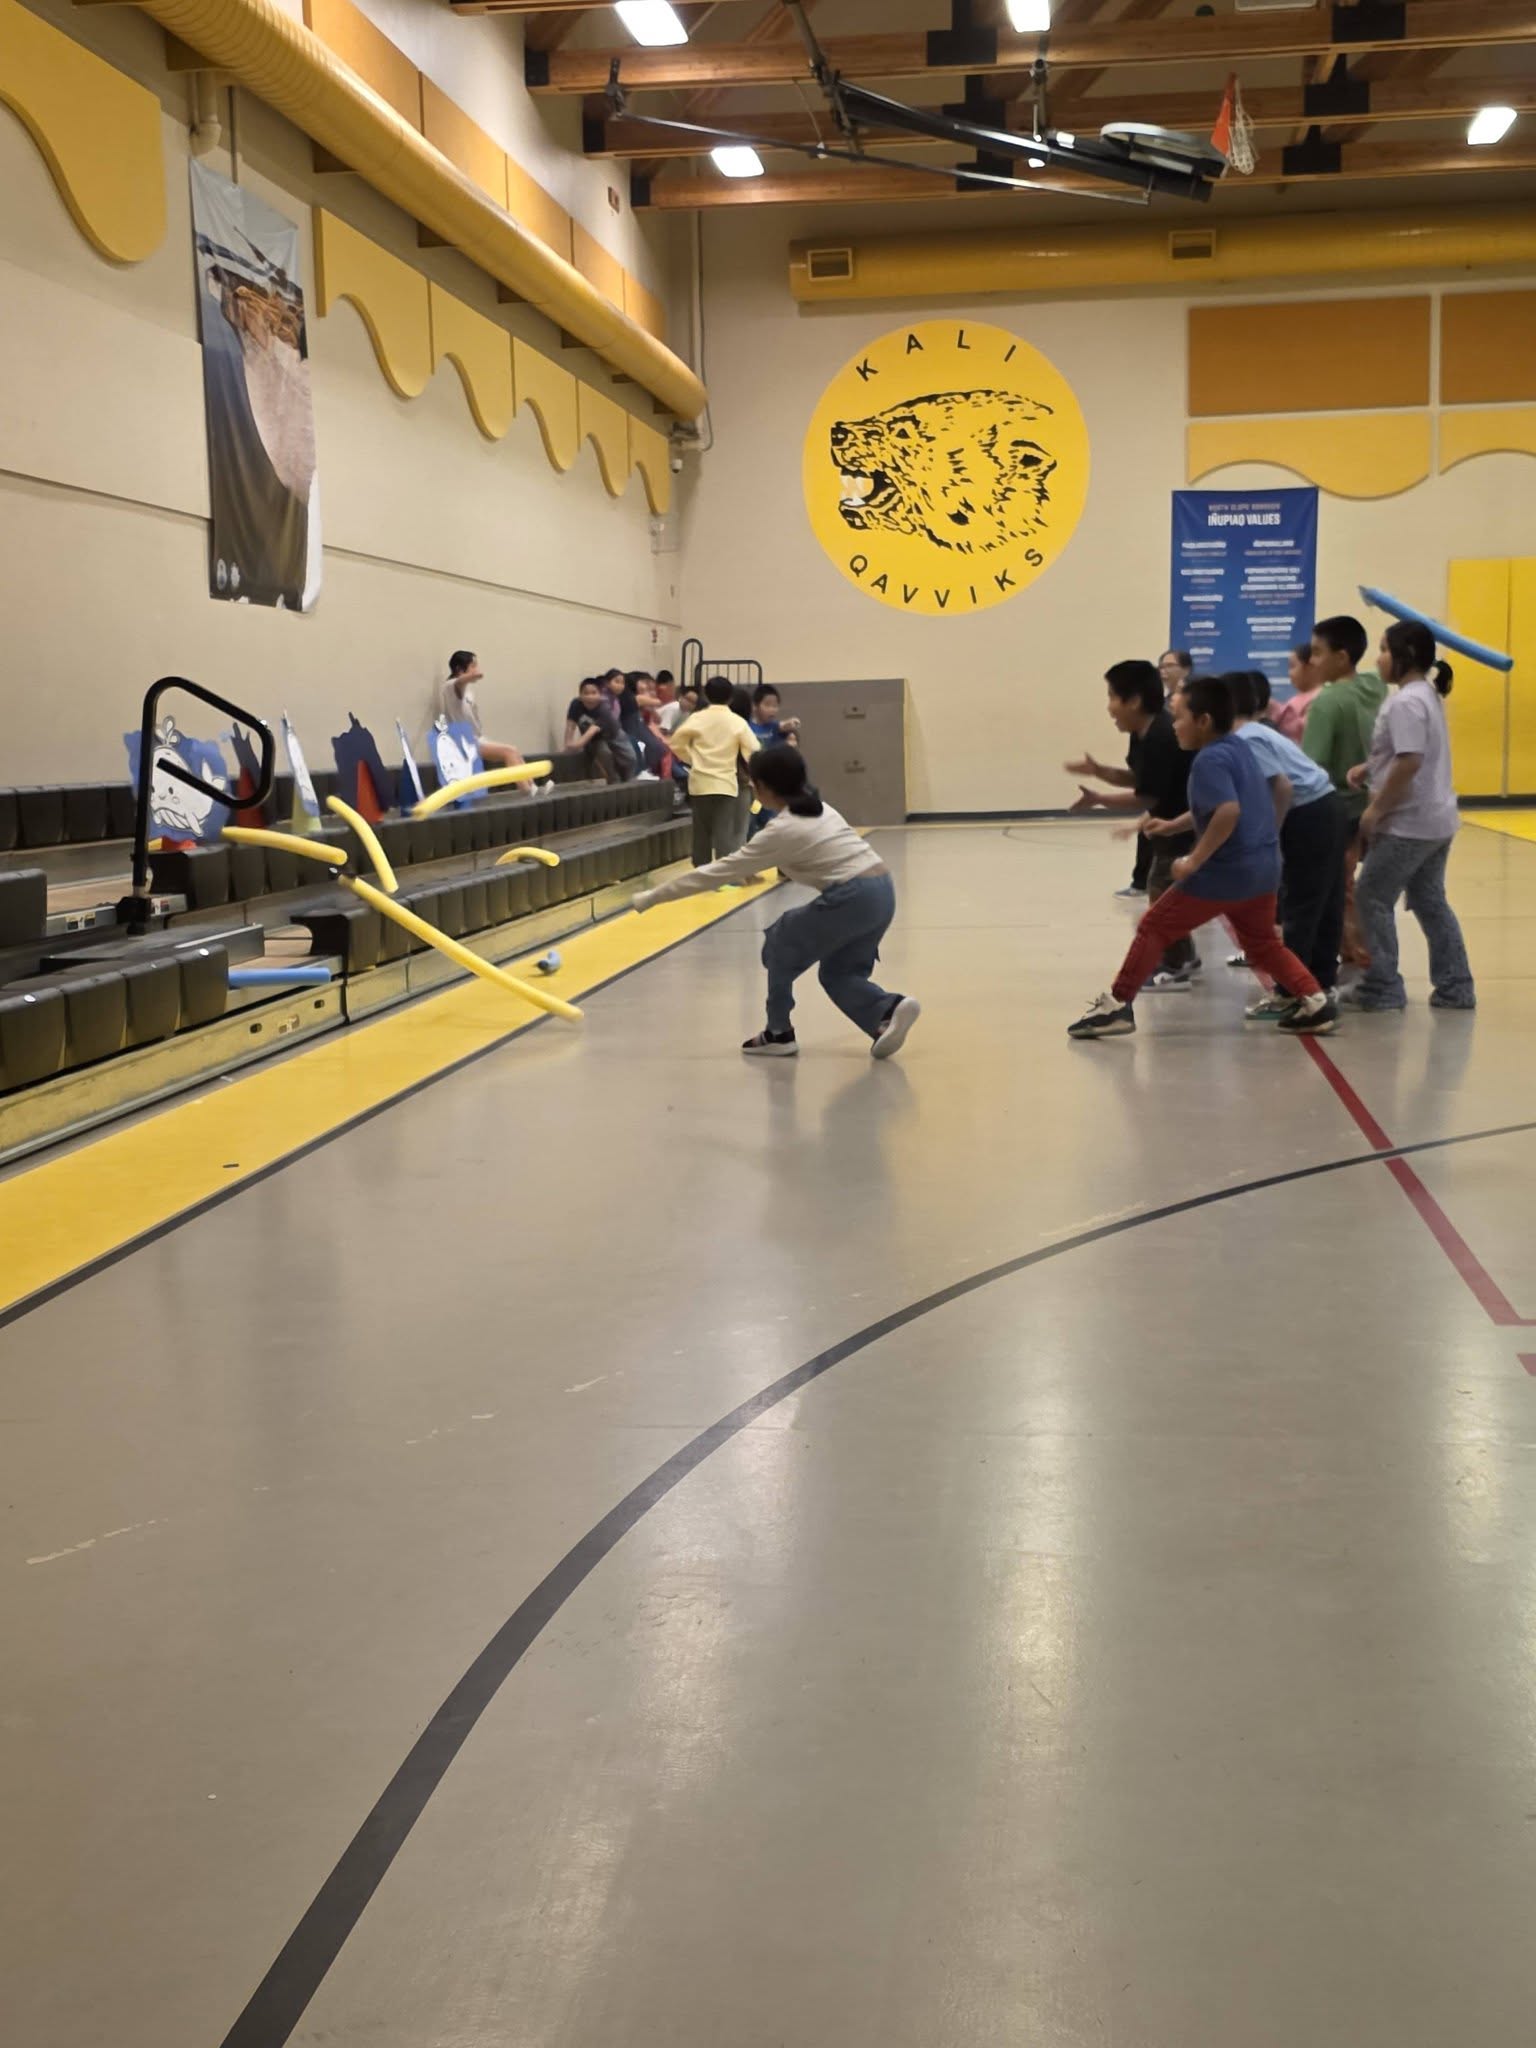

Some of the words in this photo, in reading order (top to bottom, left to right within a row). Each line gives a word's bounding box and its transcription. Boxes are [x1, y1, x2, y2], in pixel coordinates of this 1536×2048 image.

[856, 330, 1017, 382] KALI
[1208, 512, 1245, 527] IÑUPIAQ
[1246, 513, 1281, 525] VALUES
[849, 548, 1044, 609] QAVVIKS
